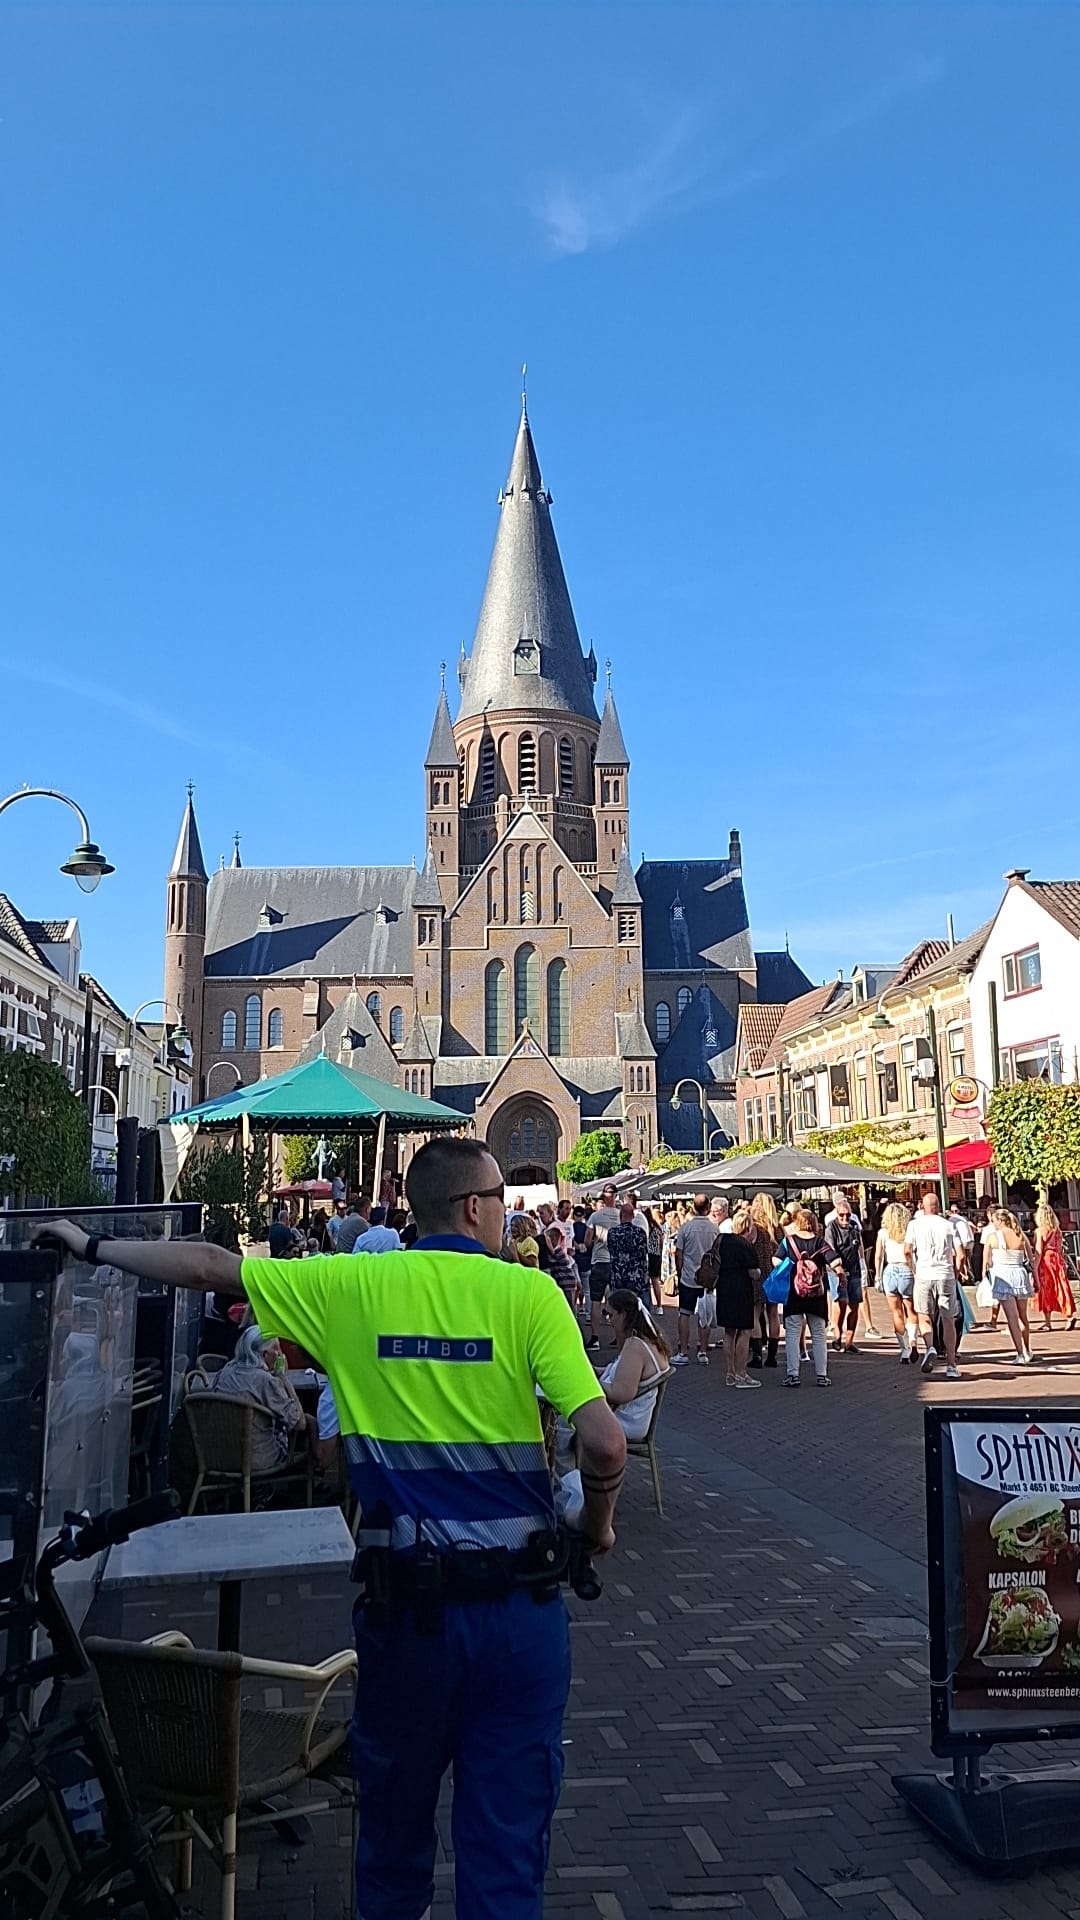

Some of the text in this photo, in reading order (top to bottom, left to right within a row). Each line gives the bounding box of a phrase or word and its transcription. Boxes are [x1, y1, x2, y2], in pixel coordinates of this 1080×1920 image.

[392, 1339, 478, 1358] EHBO
[1000, 1482, 1080, 1493] Markt 3 4651 BC Steen
[988, 1569, 1046, 1589] KAPSALON
[987, 1686, 1080, 1700] www.sphinxsteenber
